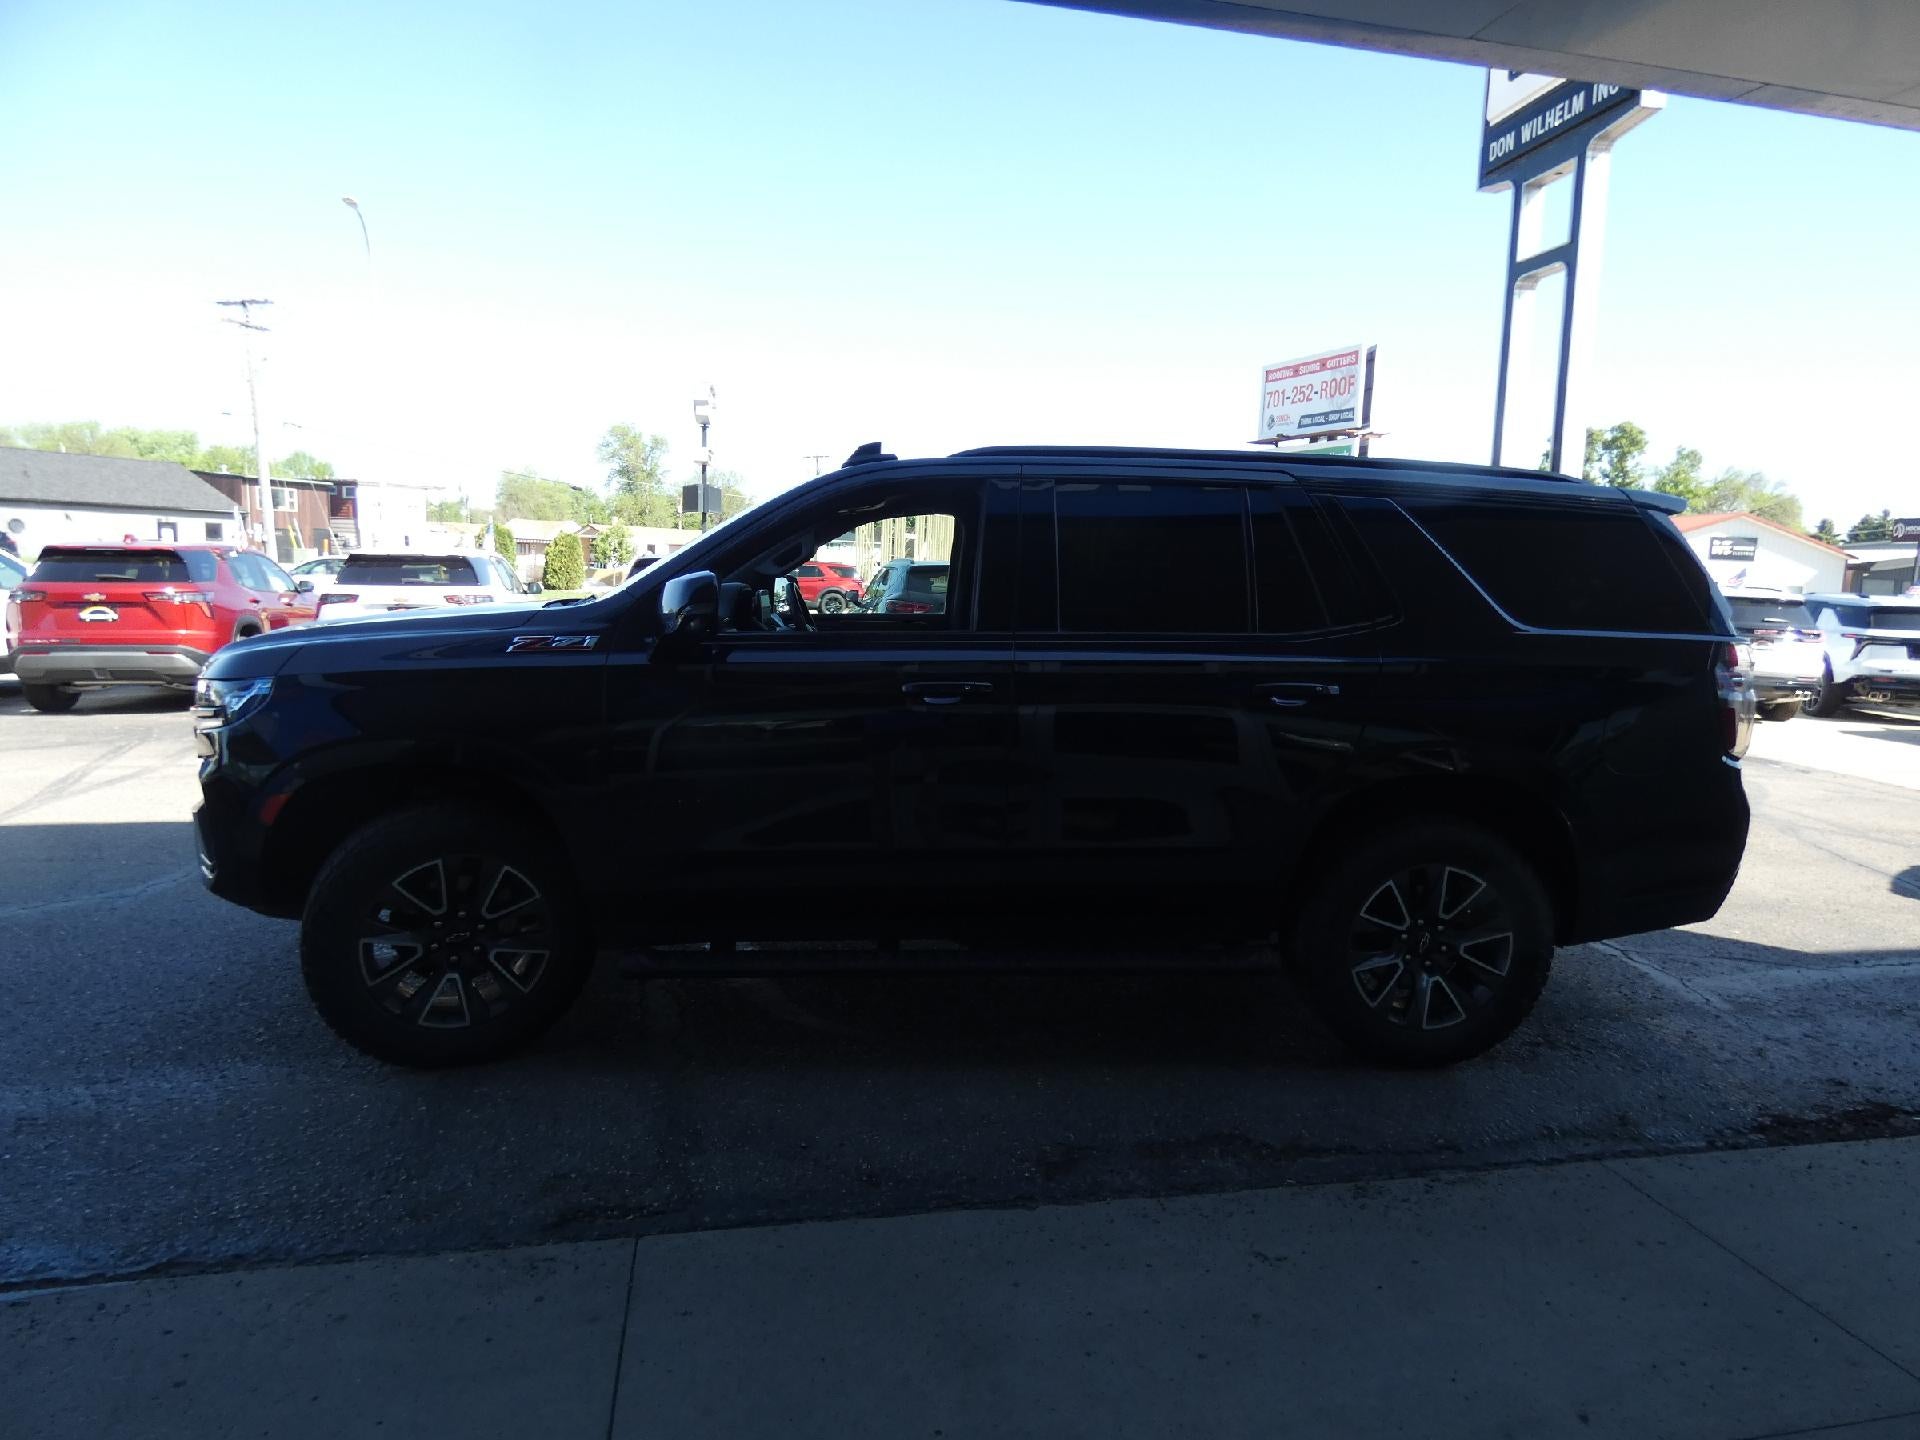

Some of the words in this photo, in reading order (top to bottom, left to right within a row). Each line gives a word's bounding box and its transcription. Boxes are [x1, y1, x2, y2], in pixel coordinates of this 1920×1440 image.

[1489, 130, 1515, 162] DON
[1521, 91, 1585, 145] WILHELM
[1326, 354, 1356, 369] GUTTERS
[1266, 374, 1356, 409] 701-252-ROOF
[506, 635, 600, 652] Z71
